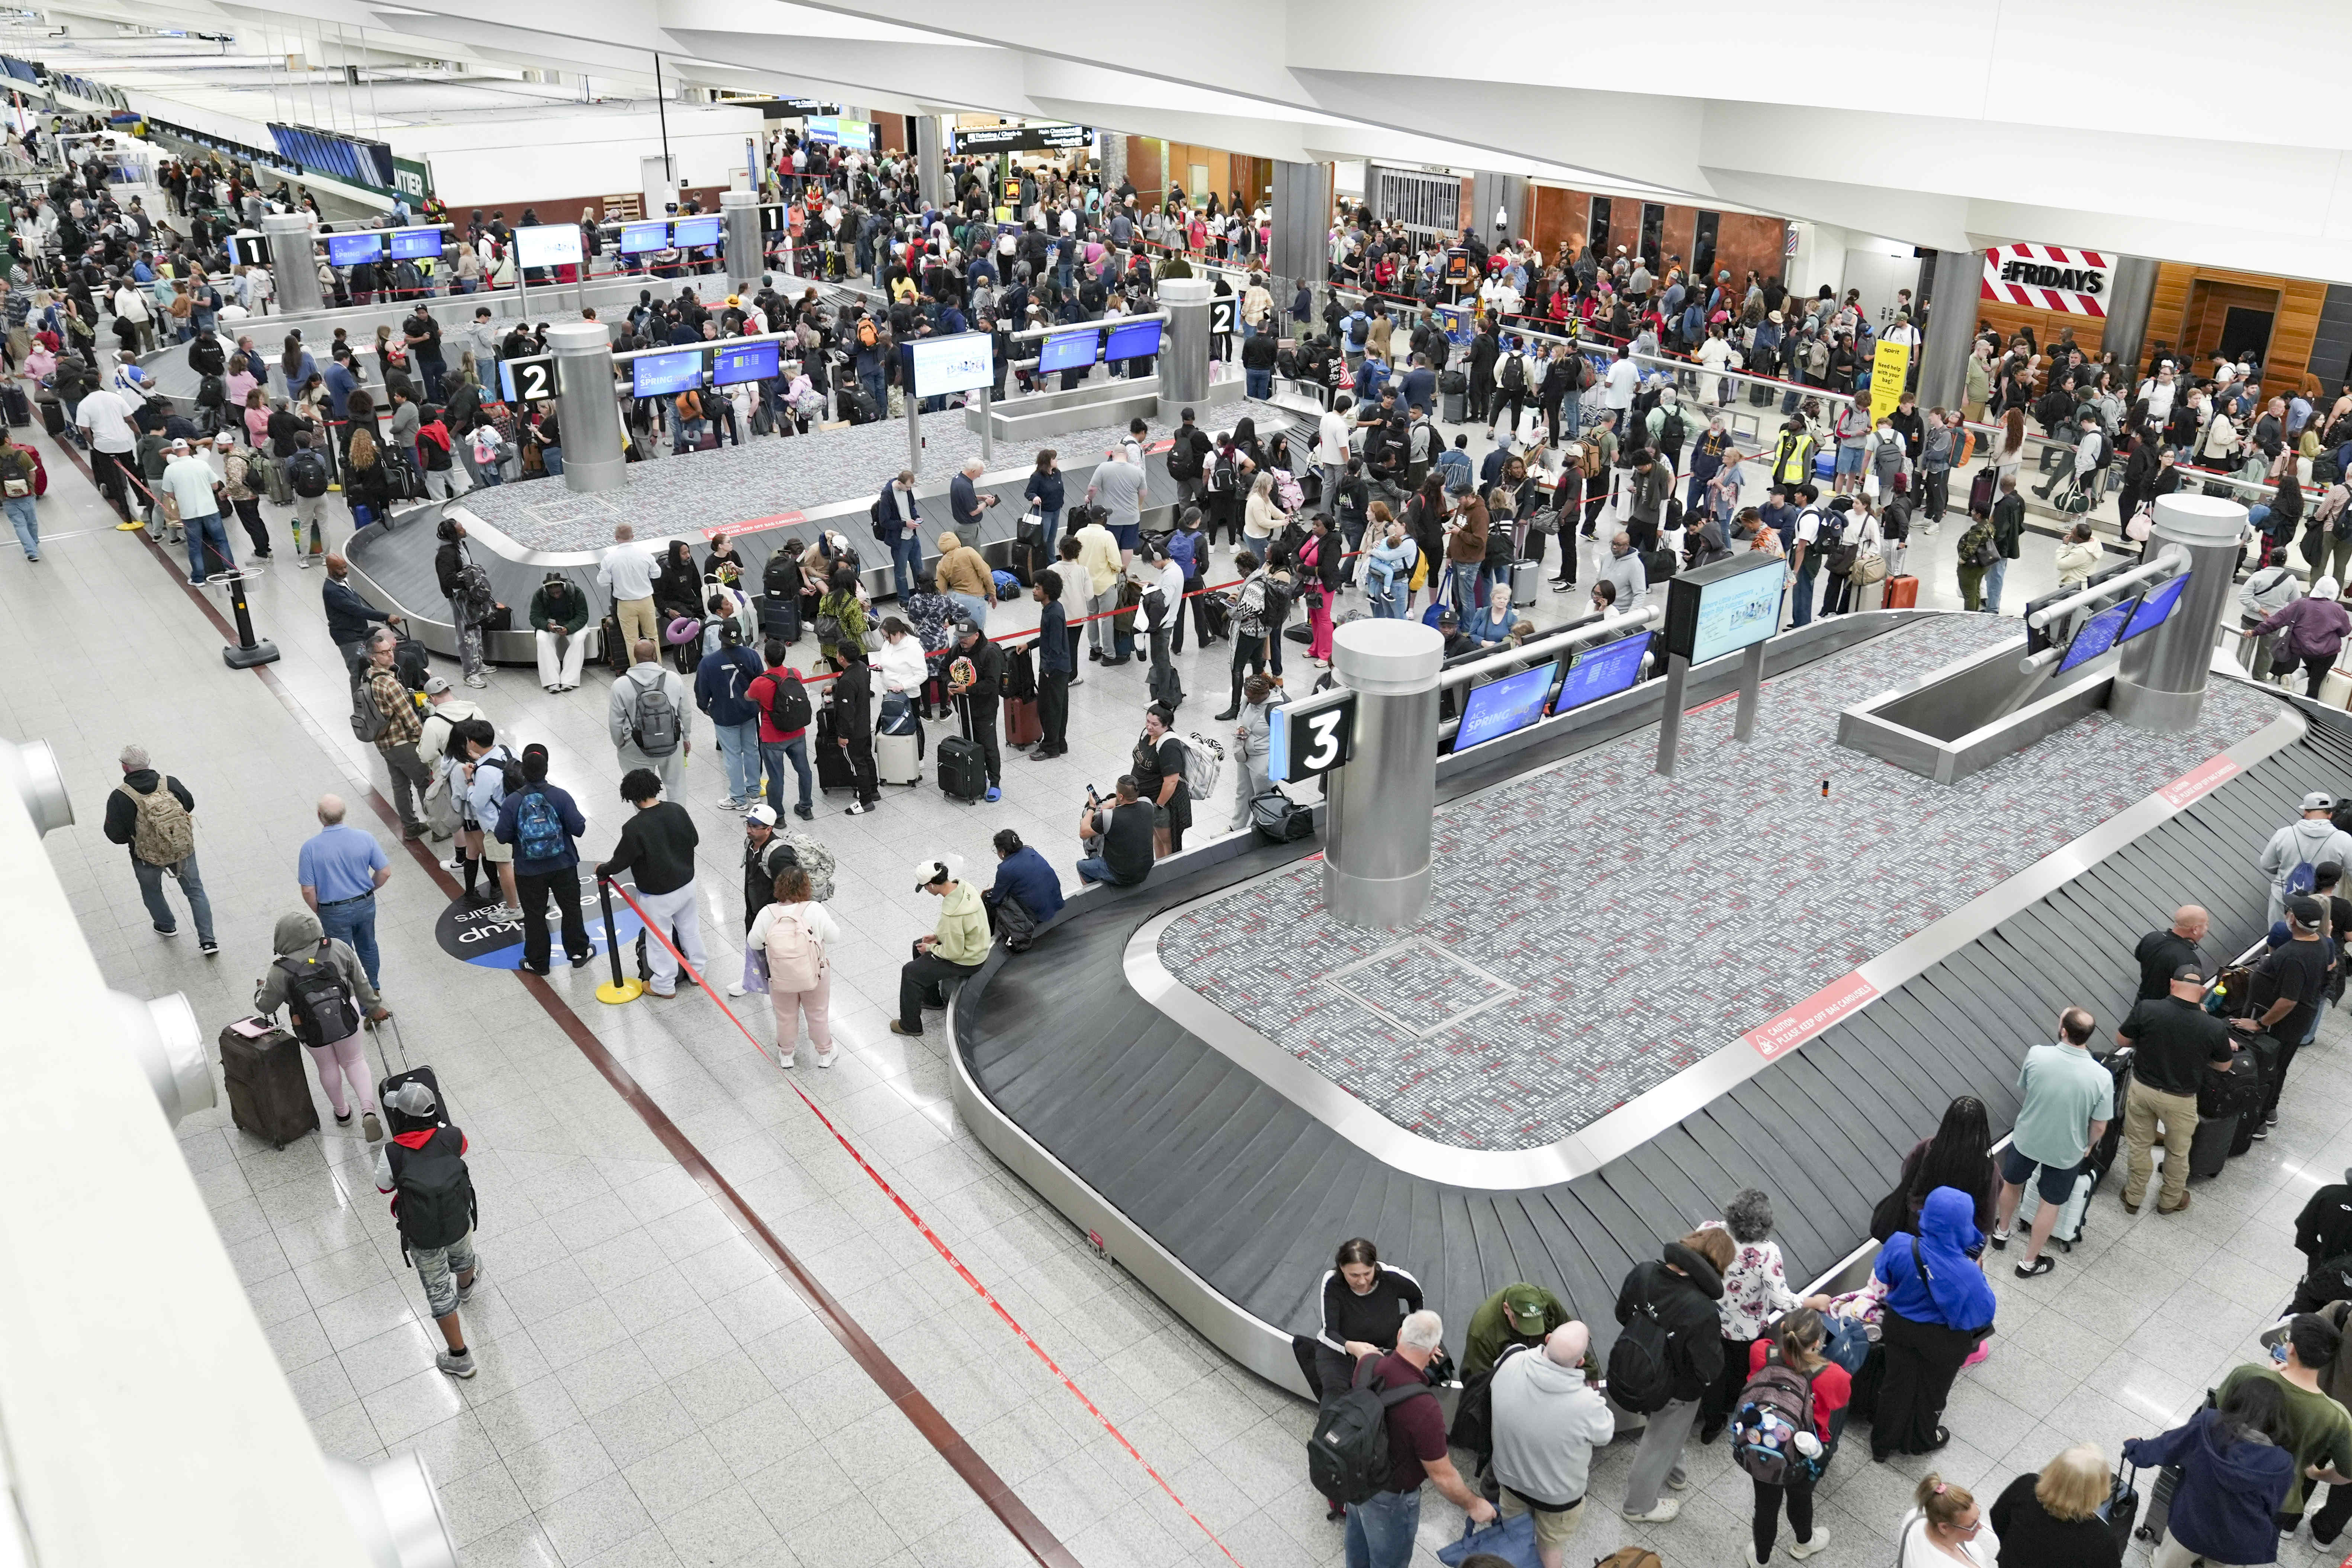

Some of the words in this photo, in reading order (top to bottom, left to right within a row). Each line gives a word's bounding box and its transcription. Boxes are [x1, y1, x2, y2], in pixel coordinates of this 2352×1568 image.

[768, 210, 776, 230] 1
[247, 240, 259, 263] 1
[1212, 304, 1230, 333] 2
[523, 366, 549, 399] 2
[640, 375, 673, 386] SPRING
[775, 516, 804, 525] CAROUSELS
[1572, 657, 1580, 666] 3
[721, 663, 740, 699] 7
[1467, 708, 1511, 733] SPRING
[1470, 709, 1486, 721] ACS
[1303, 710, 1341, 769] 3
[579, 882, 637, 905] Ube
[1767, 1017, 1797, 1036] CAUTION:
[1776, 1027, 1801, 1046] PLEASE
[1799, 1018, 1815, 1032] KEEP
[1814, 1010, 1827, 1023] OFF
[1825, 1004, 1838, 1016] BAG
[1837, 984, 1872, 1008] CAROUSELS
